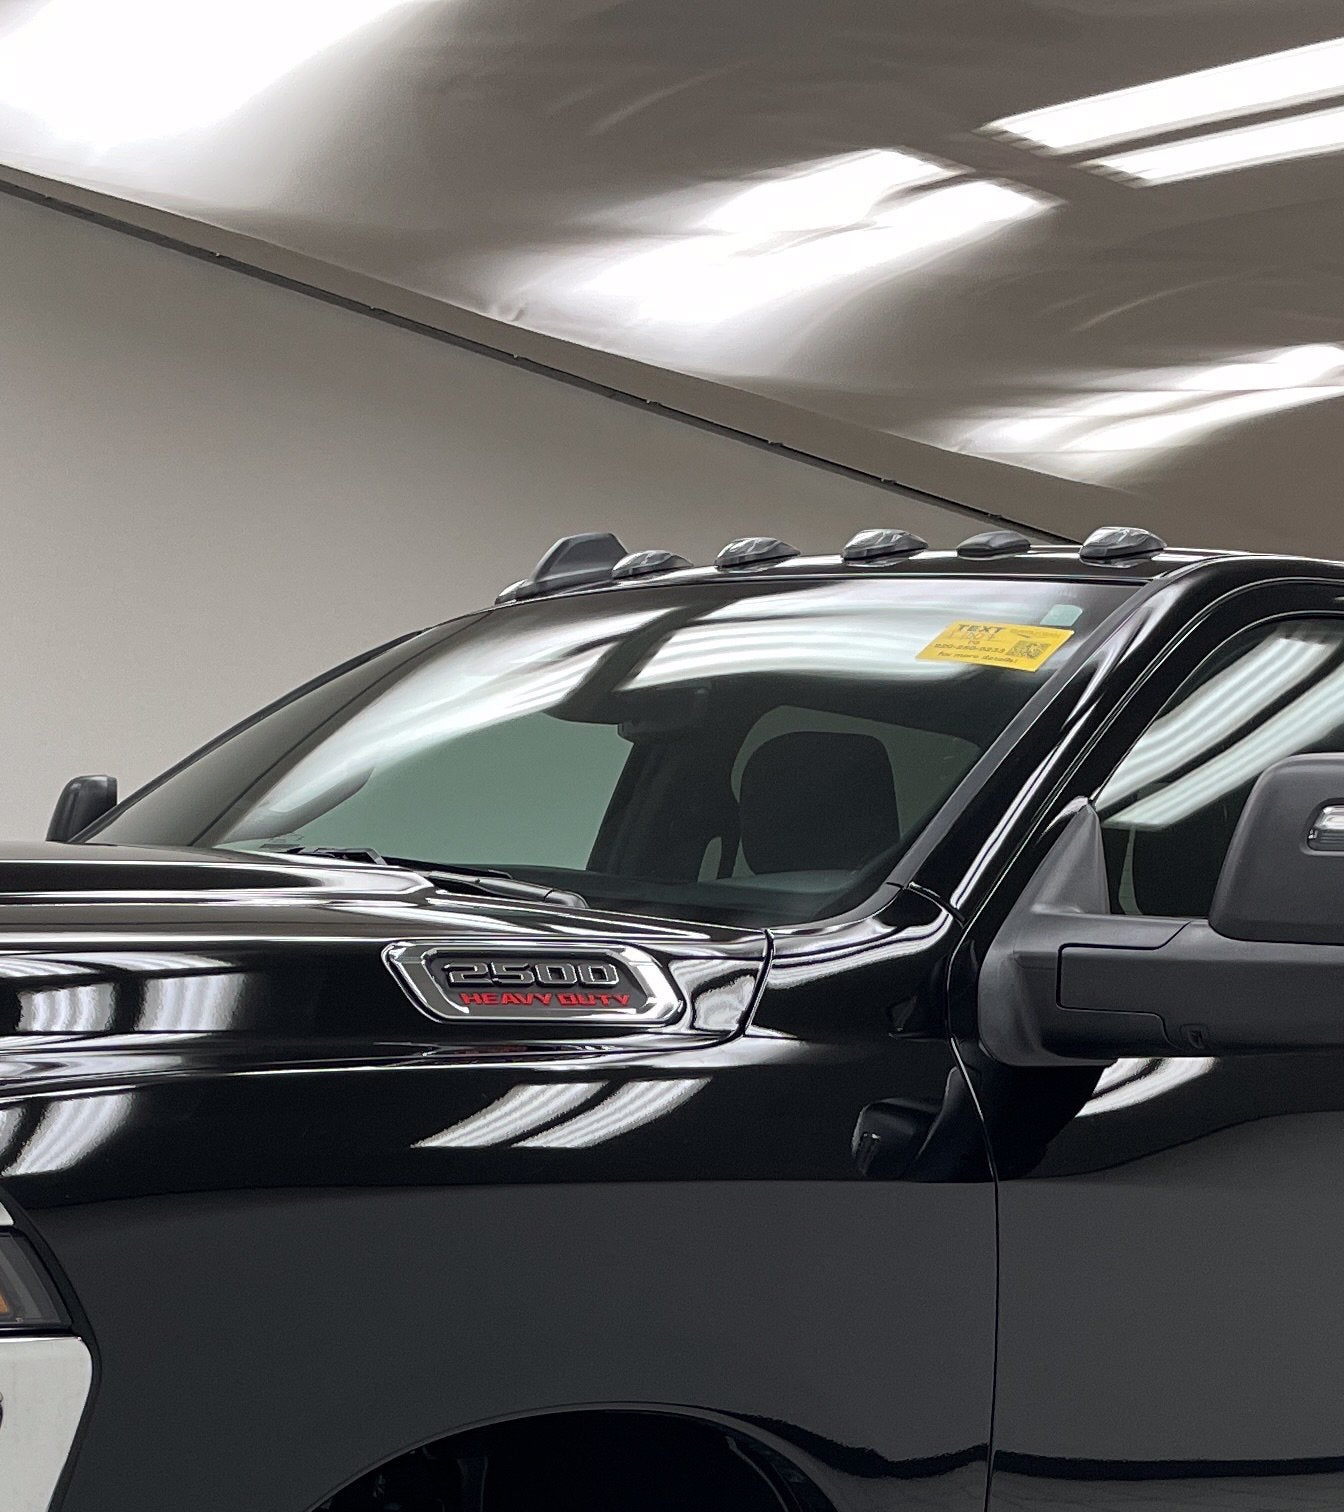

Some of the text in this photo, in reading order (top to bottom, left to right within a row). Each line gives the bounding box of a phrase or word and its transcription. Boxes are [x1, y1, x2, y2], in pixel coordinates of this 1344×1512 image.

[958, 623, 1005, 634] TEXT
[442, 960, 620, 988] 2500
[460, 992, 630, 1007] HEAVY DUTY
